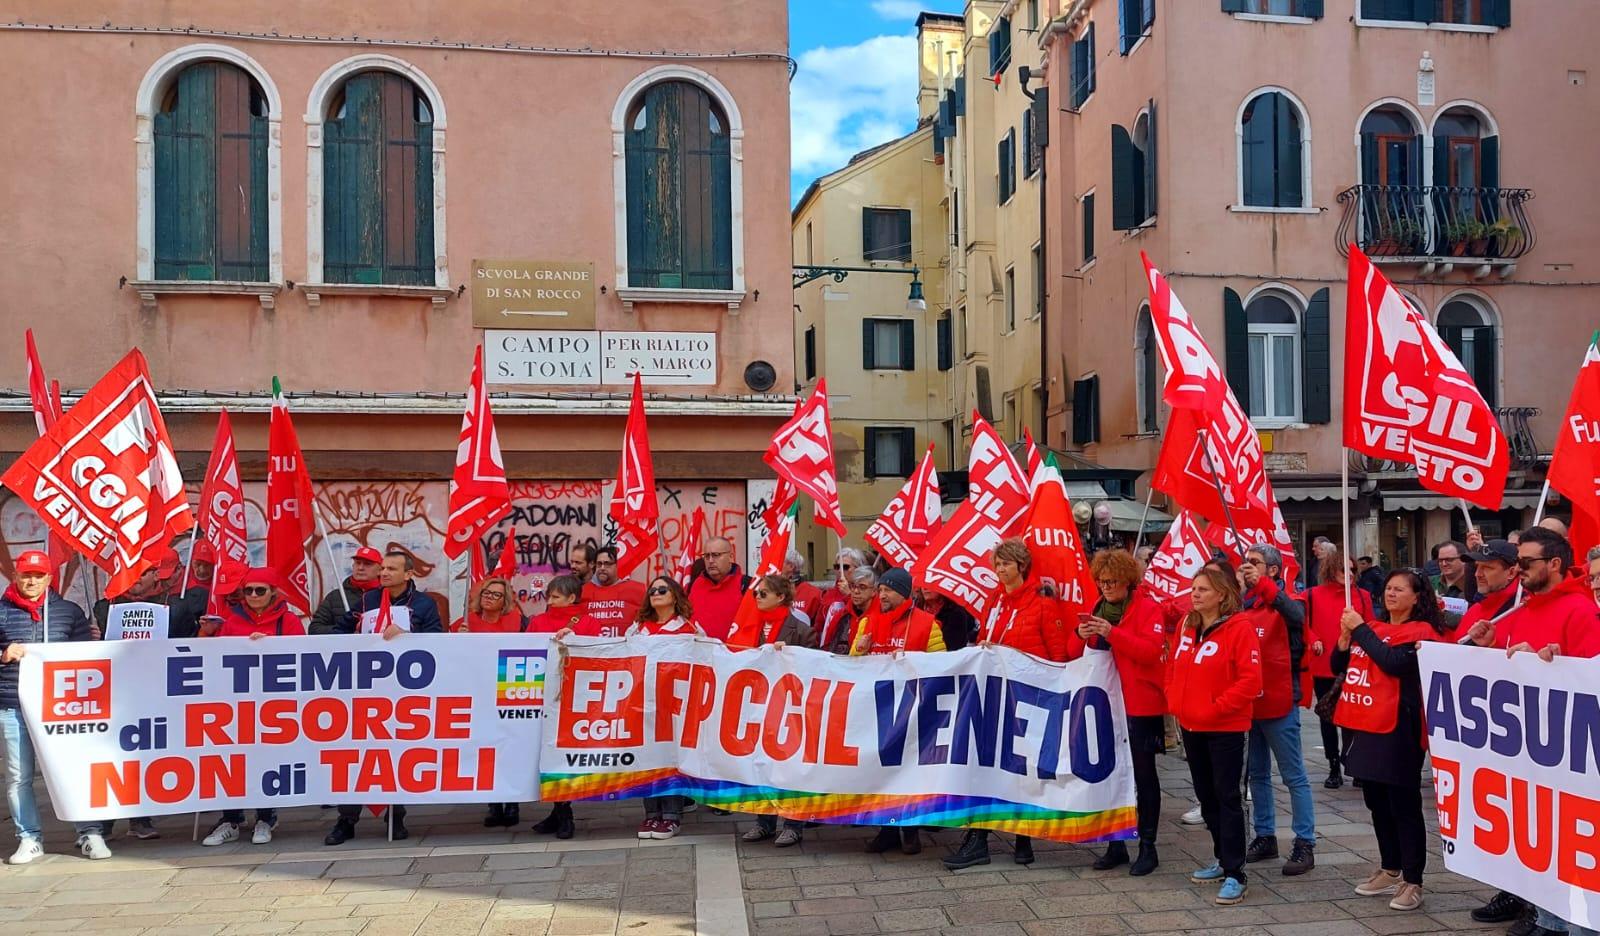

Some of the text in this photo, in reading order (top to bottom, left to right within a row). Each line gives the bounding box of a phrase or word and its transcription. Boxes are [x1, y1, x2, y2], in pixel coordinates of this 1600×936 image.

[477, 268, 589, 281] SCVOLA GRANDE
[486, 287, 581, 300] DI SAN ROCCO
[502, 336, 590, 354] CAMPO
[607, 338, 710, 352] PER RIALTO
[498, 361, 514, 377] S.
[605, 356, 712, 370] E S. MARCO
[1361, 421, 1485, 491] VEETO
[71, 455, 149, 545] CGIL
[122, 608, 154, 619] SANITÀ
[121, 618, 154, 628] VENETO
[122, 631, 151, 640] BASTA
[167, 646, 437, 697] È TEMPO
[506, 656, 546, 683] FP
[54, 668, 105, 699] FP
[572, 670, 634, 713] FP
[53, 700, 102, 716] CGIL
[498, 708, 547, 719] VENET
[44, 722, 109, 735] VENETO
[119, 696, 473, 752] di RISORSE
[572, 719, 631, 741] CGIL
[655, 661, 1116, 785] FP CGIL VENETO
[566, 752, 635, 767] VENETO
[89, 747, 496, 808] NON di TAGLI
